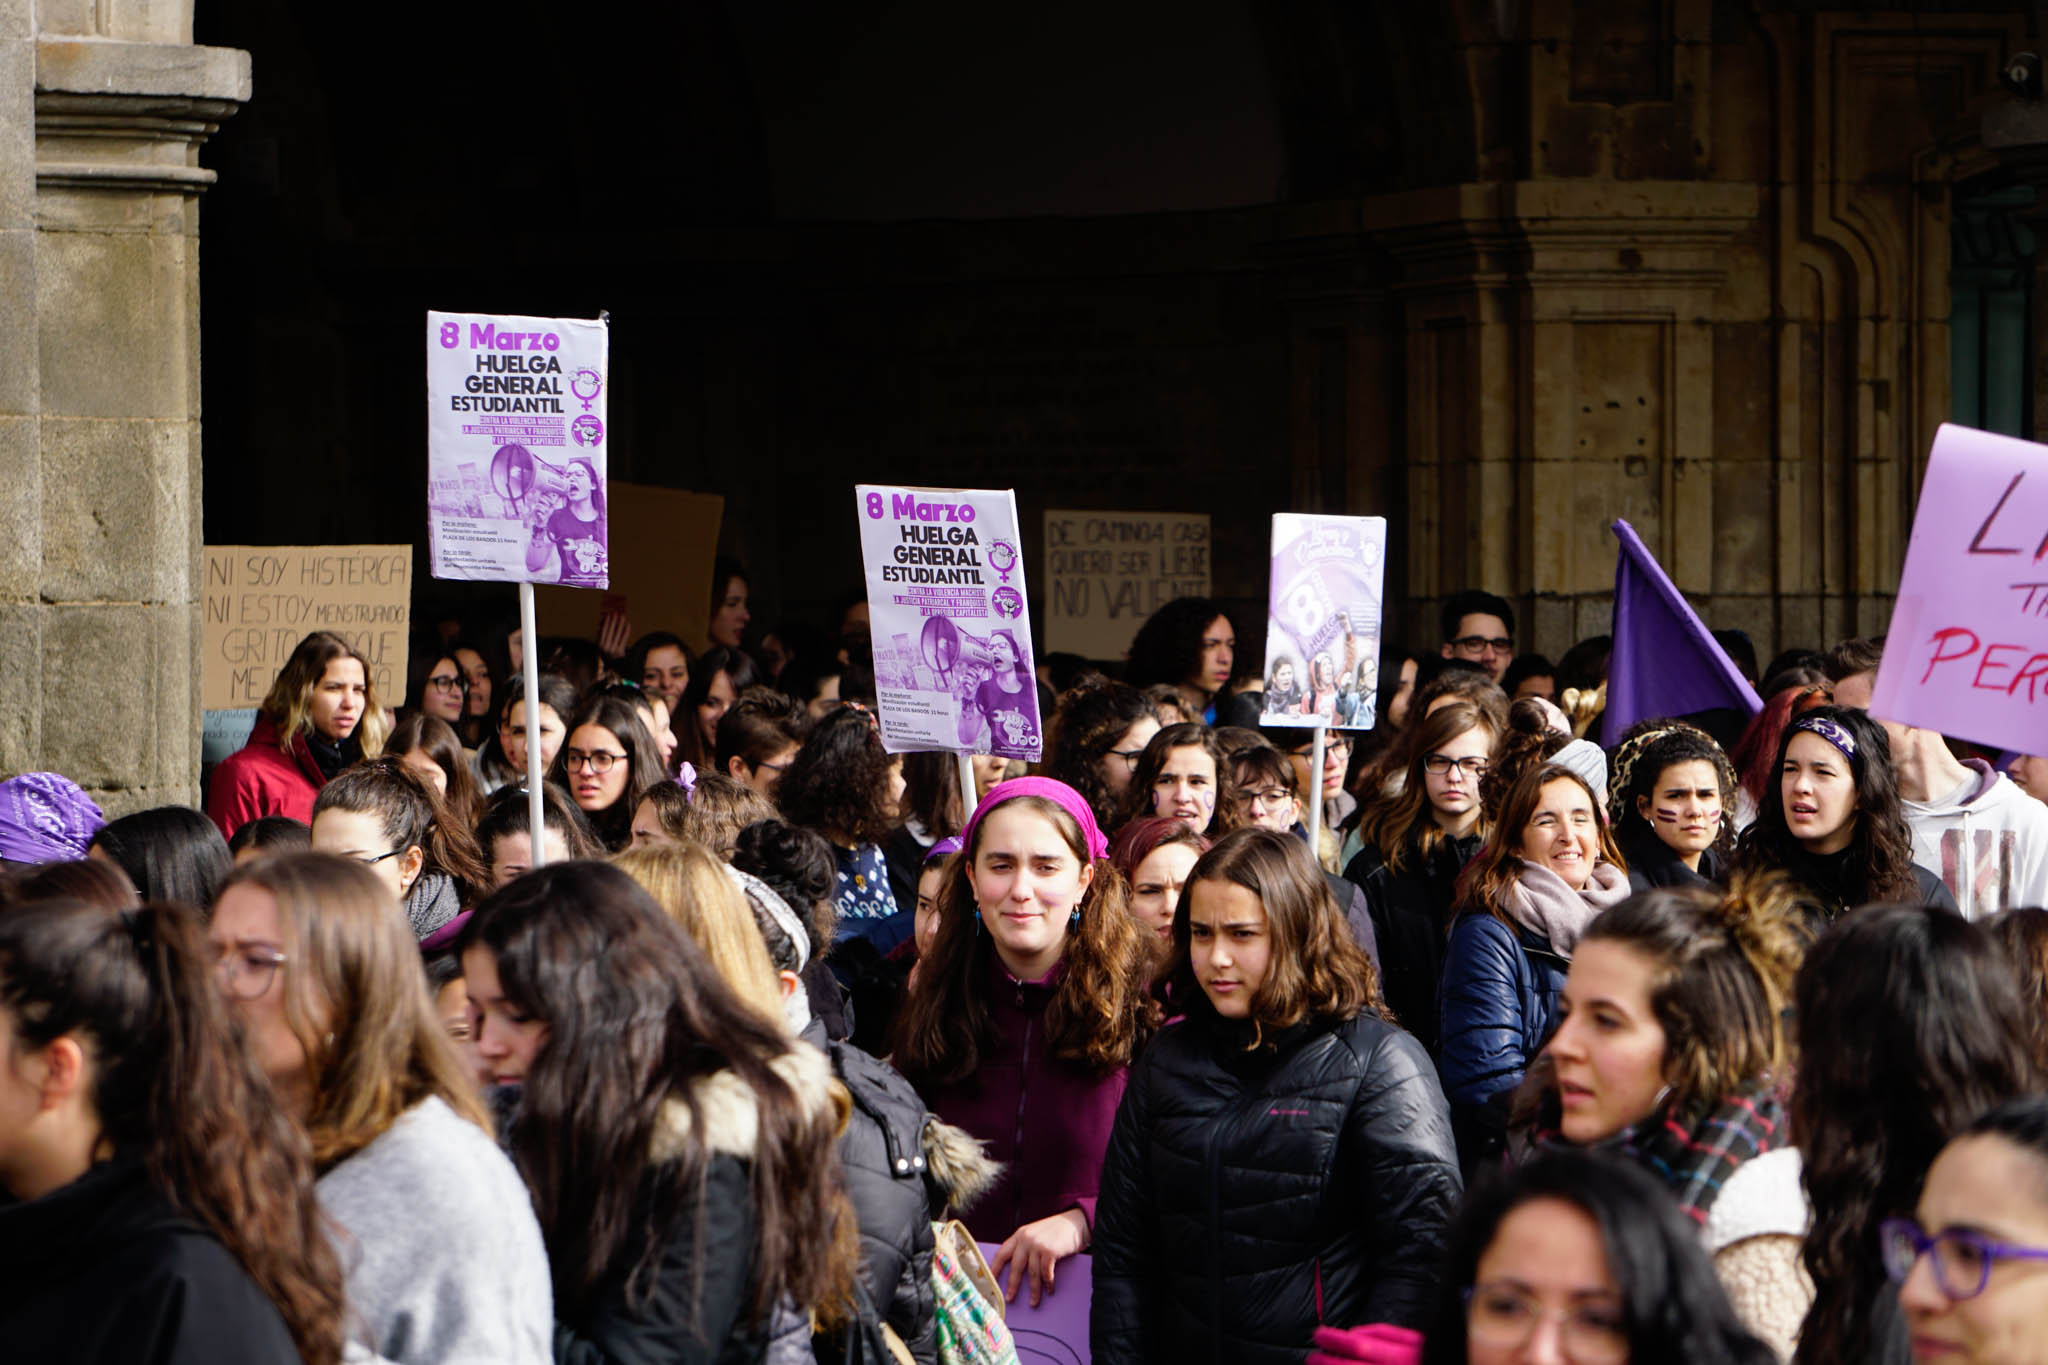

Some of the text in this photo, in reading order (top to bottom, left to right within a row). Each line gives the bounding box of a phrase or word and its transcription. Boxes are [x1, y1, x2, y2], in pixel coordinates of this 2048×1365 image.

[440, 322, 561, 351] 8 Marzo
[476, 354, 562, 374] HUELGA
[465, 375, 563, 395] GENERAL
[451, 396, 564, 413] ESTUDIANTIL
[866, 492, 976, 523] 8 Marzo
[901, 525, 979, 546] HUELGA
[1048, 520, 1075, 547] DE
[1173, 521, 1208, 544] CASA
[209, 551, 407, 587] NI SOY HISTÉRICA
[894, 545, 981, 567] GENERAL
[1050, 546, 1206, 577] QUIERO SER LIBRE
[882, 565, 984, 584] ESTUDIANTIL
[208, 594, 405, 625] NI ESTOY MENSTRUANDO
[1053, 578, 1089, 617] NO
[1288, 583, 1325, 637] 8
[231, 667, 265, 700] ME
